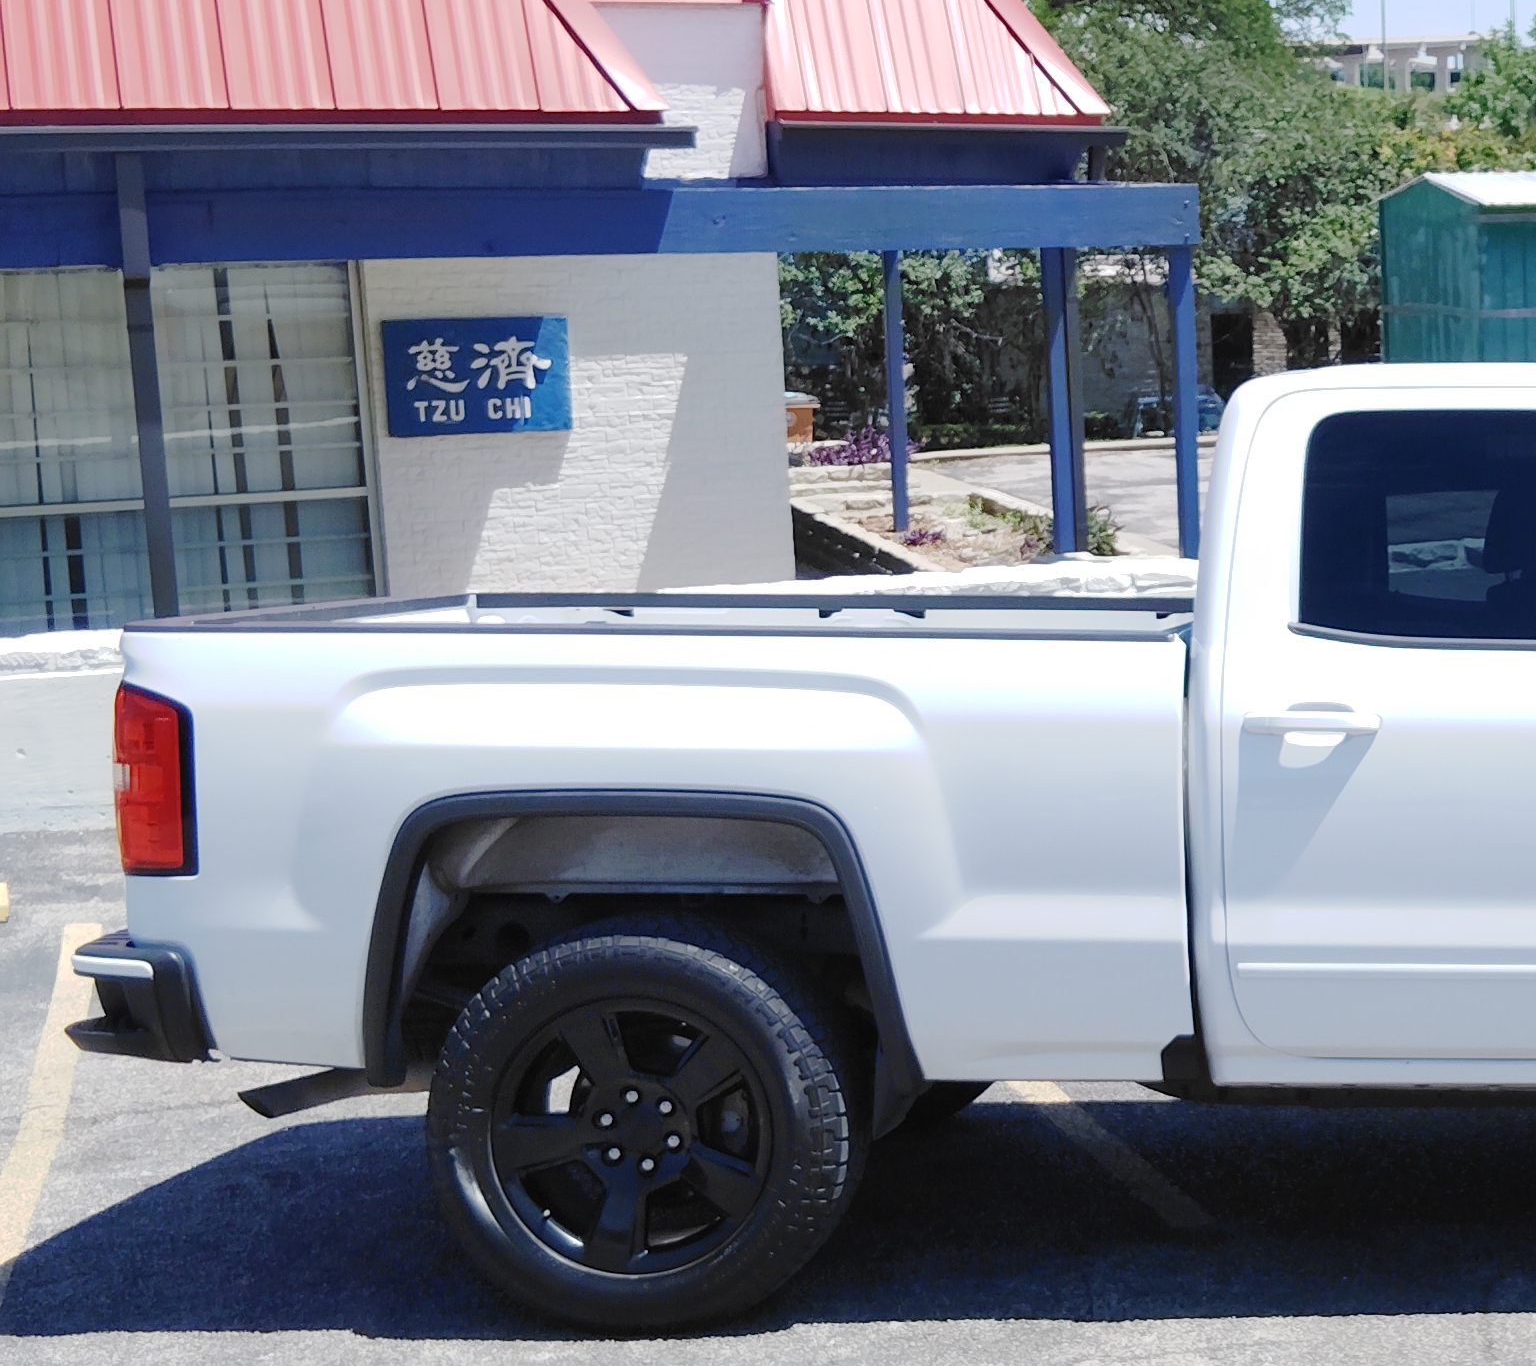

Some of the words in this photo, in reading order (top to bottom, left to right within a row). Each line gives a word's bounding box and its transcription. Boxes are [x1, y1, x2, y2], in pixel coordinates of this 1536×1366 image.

[406, 335, 552, 393] 慈濟
[413, 399, 465, 423] TZU
[487, 396, 532, 420] CHI
